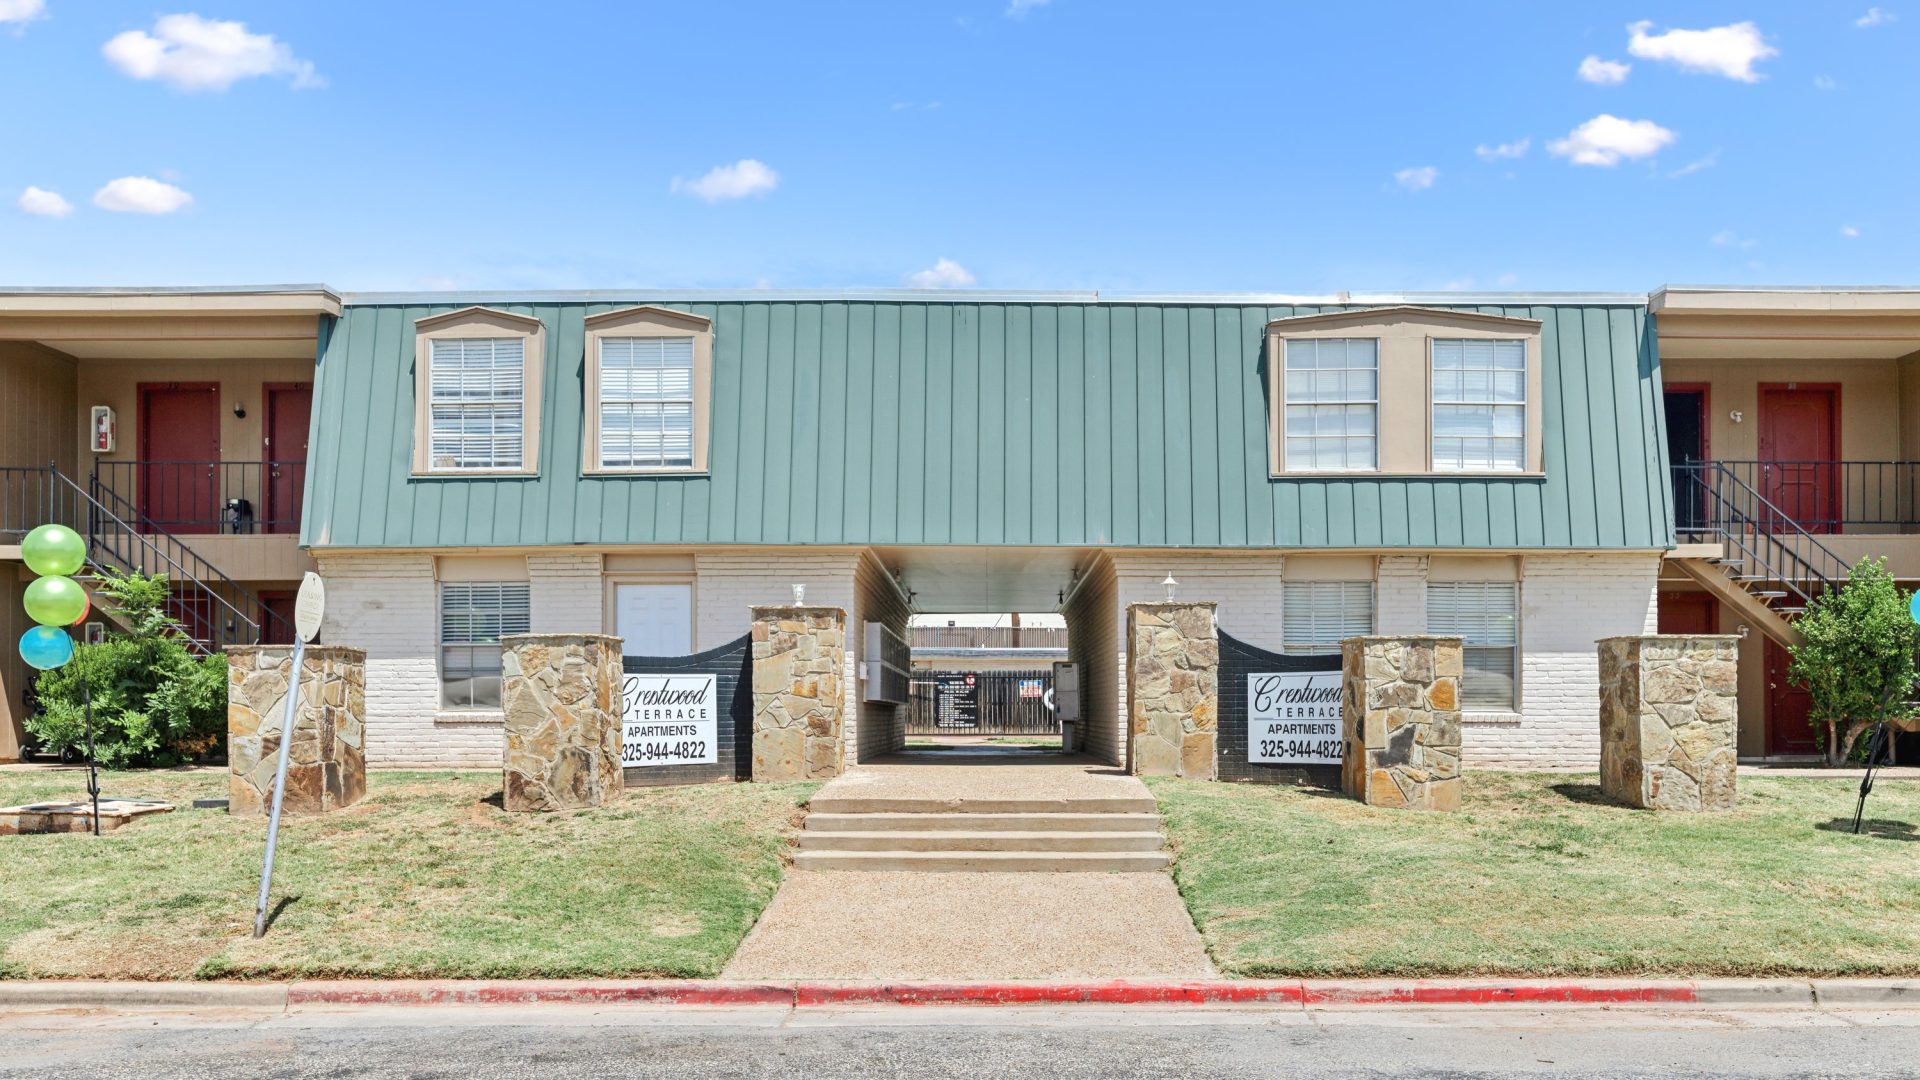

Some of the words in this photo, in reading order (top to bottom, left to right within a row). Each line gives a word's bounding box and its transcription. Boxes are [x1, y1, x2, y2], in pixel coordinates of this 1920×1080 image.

[634, 708, 707, 720] TERRACE
[1276, 706, 1343, 718] TERRACE
[627, 724, 697, 738] APARTMENTS
[1267, 723, 1336, 735] APARTMENTS
[622, 740, 706, 762] 325-944-4822
[1260, 739, 1343, 759] 325-944-4822
